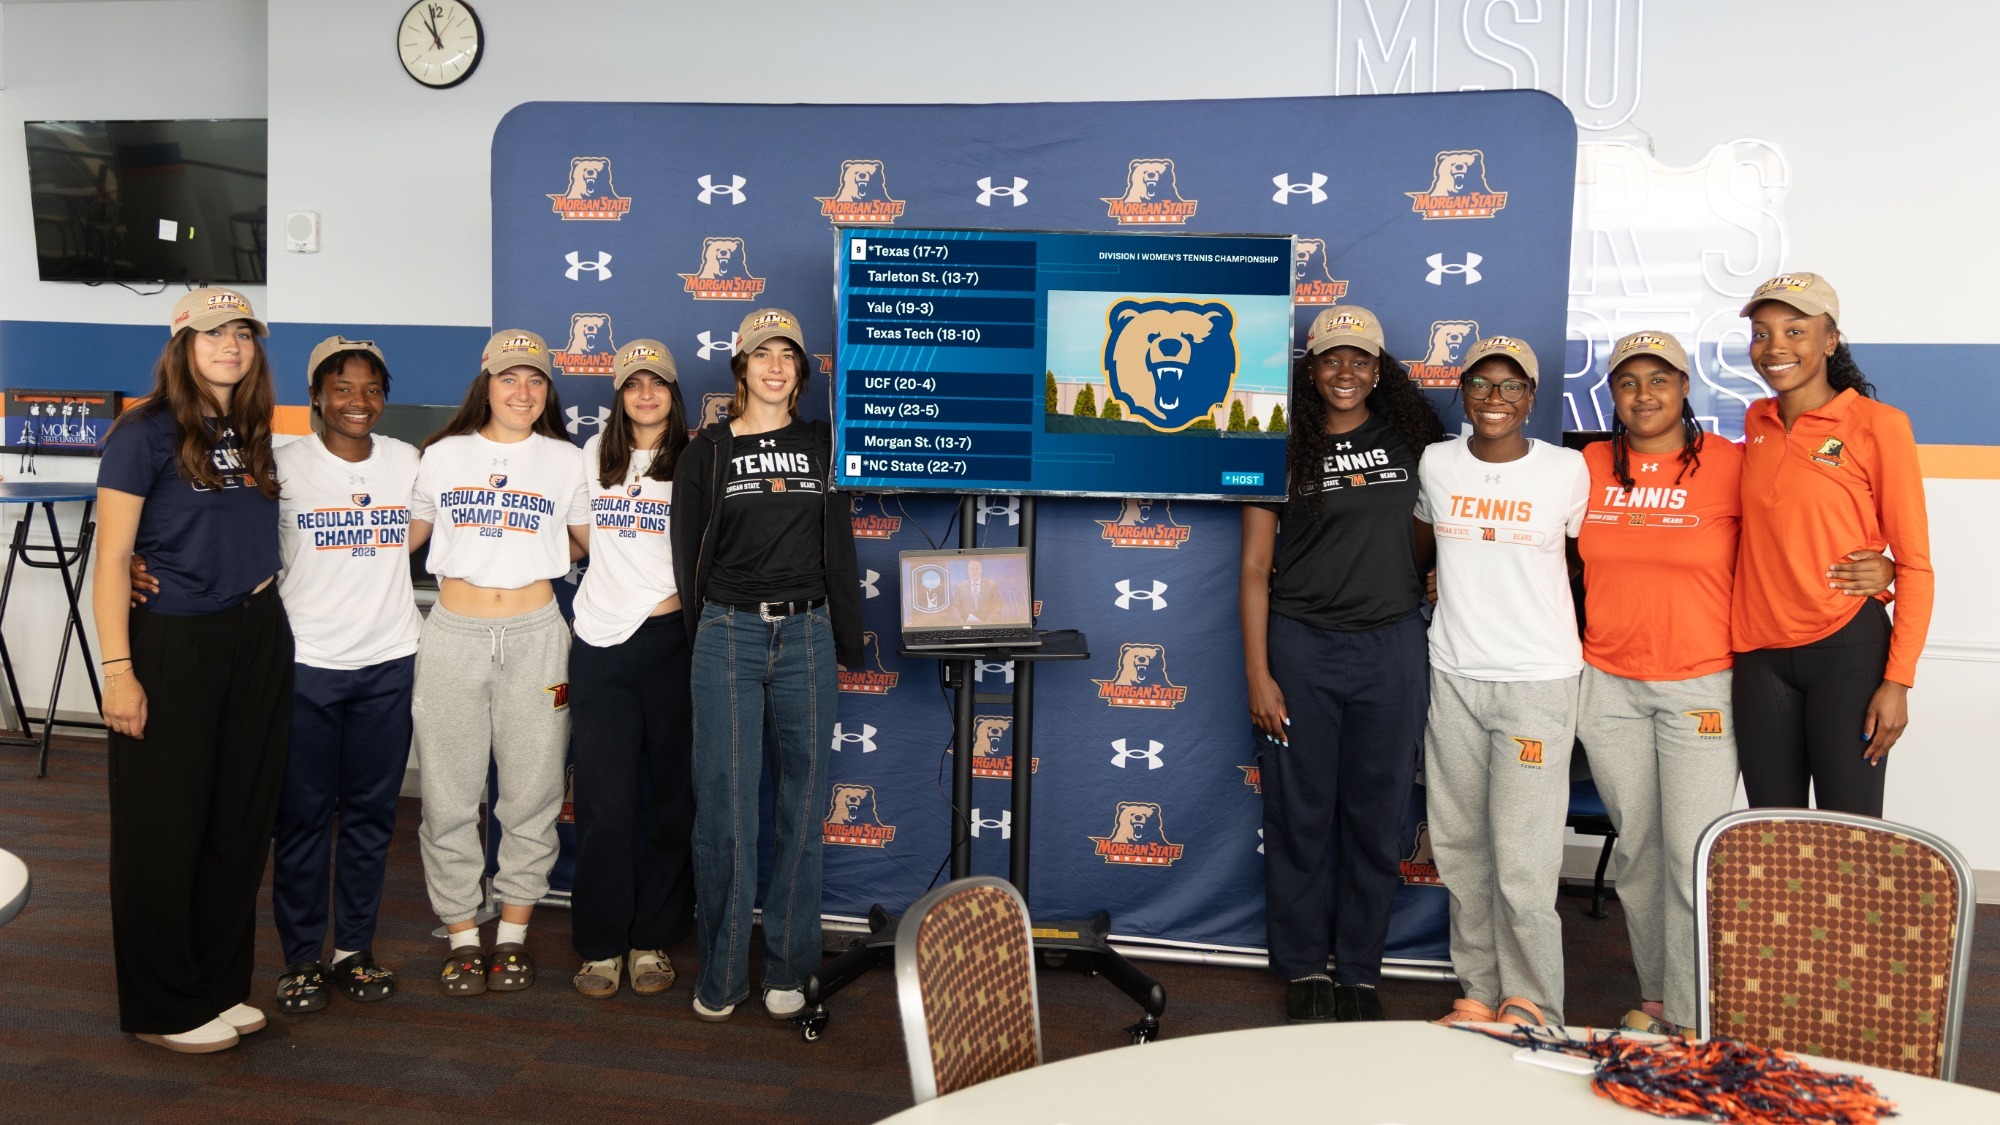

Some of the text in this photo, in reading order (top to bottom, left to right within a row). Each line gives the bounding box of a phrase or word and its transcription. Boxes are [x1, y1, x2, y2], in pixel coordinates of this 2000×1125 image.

[431, 6, 443, 18] 12
[555, 196, 628, 211] MORGAN STATE
[823, 200, 902, 214] MORGAN STATE
[1110, 199, 1196, 216] MORGAN STATE
[1415, 193, 1503, 210] MORGAN STATE
[1432, 209, 1486, 217] BEARS
[913, 245, 949, 260] (17-7)
[1099, 252, 1136, 261] DIVISION
[1141, 253, 1181, 262] WOMEN'S
[1183, 254, 1213, 262] TENNIS
[1214, 254, 1279, 264] CHAMPIONSHIP
[686, 276, 763, 292] MORGAN STATE
[867, 270, 979, 286] Tarleton St. (13-7)
[1311, 280, 1344, 295] STATE
[867, 301, 934, 317] Yale (19-3)
[753, 314, 792, 327] CHAMPS
[1327, 316, 1365, 329] CHAMPS
[866, 327, 981, 343] Texas Tech (18-10)
[502, 338, 540, 351] CHAMPS
[1622, 336, 1667, 350] CHAMPS
[555, 351, 603, 367] MORGAN
[624, 348, 660, 362] CHAMPS
[864, 377, 937, 392] UCF (20-4)
[864, 403, 939, 418] Navy (23-5)
[864, 436, 972, 451] Morgan St. (13-7)
[731, 452, 810, 475] TENNIS
[851, 462, 856, 470] 8
[891, 460, 924, 472] State
[927, 460, 967, 475] (22-7)
[1323, 448, 1389, 473] ENNIS
[744, 482, 760, 490] STATE
[440, 490, 556, 516] REGULAR SEASON
[1603, 486, 1688, 509] TENNIS
[590, 498, 672, 517] REGULAR SEASO
[1450, 495, 1533, 522] TENNIS
[297, 509, 411, 530] REGULAR SEASO
[867, 514, 898, 530] STATE
[480, 526, 503, 538] 2026
[618, 529, 637, 539] 2026
[1105, 523, 1187, 539] MORGAN STATE
[1513, 533, 1532, 541] BEARS
[352, 547, 376, 557] 2026
[839, 669, 898, 686] RGAN STATE
[1101, 682, 1183, 700] MORGAN STATE
[972, 769, 1009, 777] BEAR
[863, 824, 891, 839] STATE
[1098, 840, 1181, 857] MORGAN STATE
